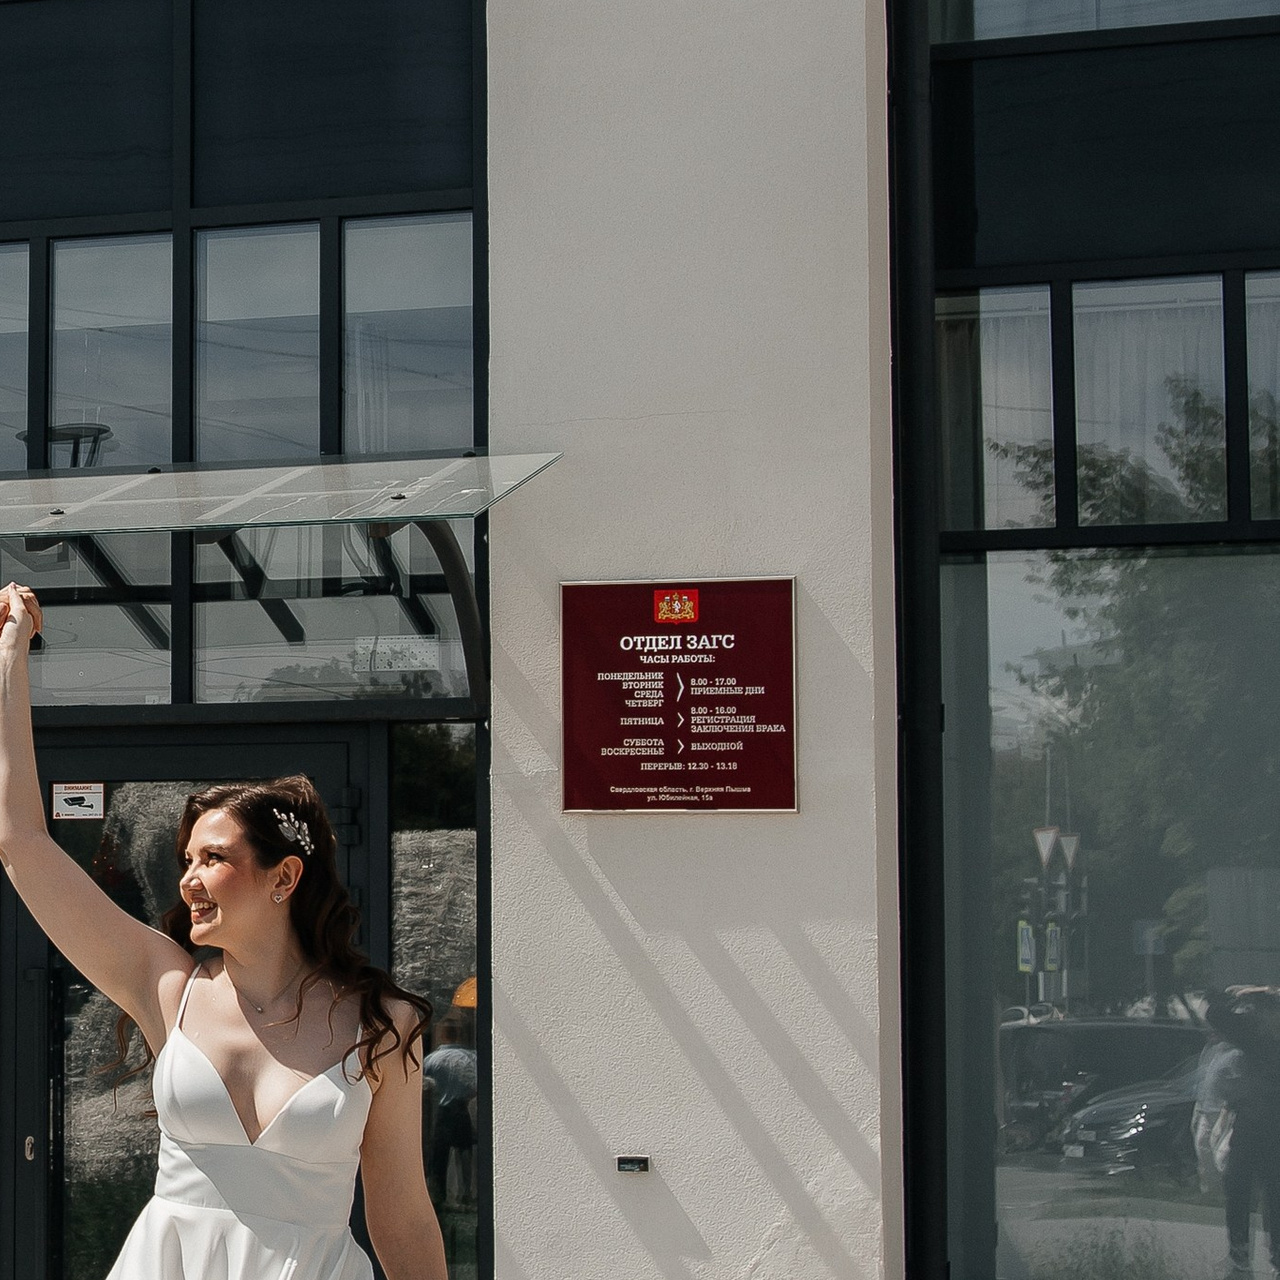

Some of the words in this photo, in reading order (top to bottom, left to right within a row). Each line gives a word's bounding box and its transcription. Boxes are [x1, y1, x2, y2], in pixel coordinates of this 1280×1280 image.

[620, 635, 681, 651] ОТДЕЛ
[687, 635, 734, 649] ЗАГС
[640, 655, 670, 664] ЧАСЫ
[672, 654, 715, 663] РАБОТЫ:
[598, 672, 663, 680] ПОНЕДЕЛЬНИК
[623, 681, 664, 689] ВТОРНИК
[745, 687, 764, 695] ДНИ
[691, 741, 743, 751] ВЫХОДНОЙ
